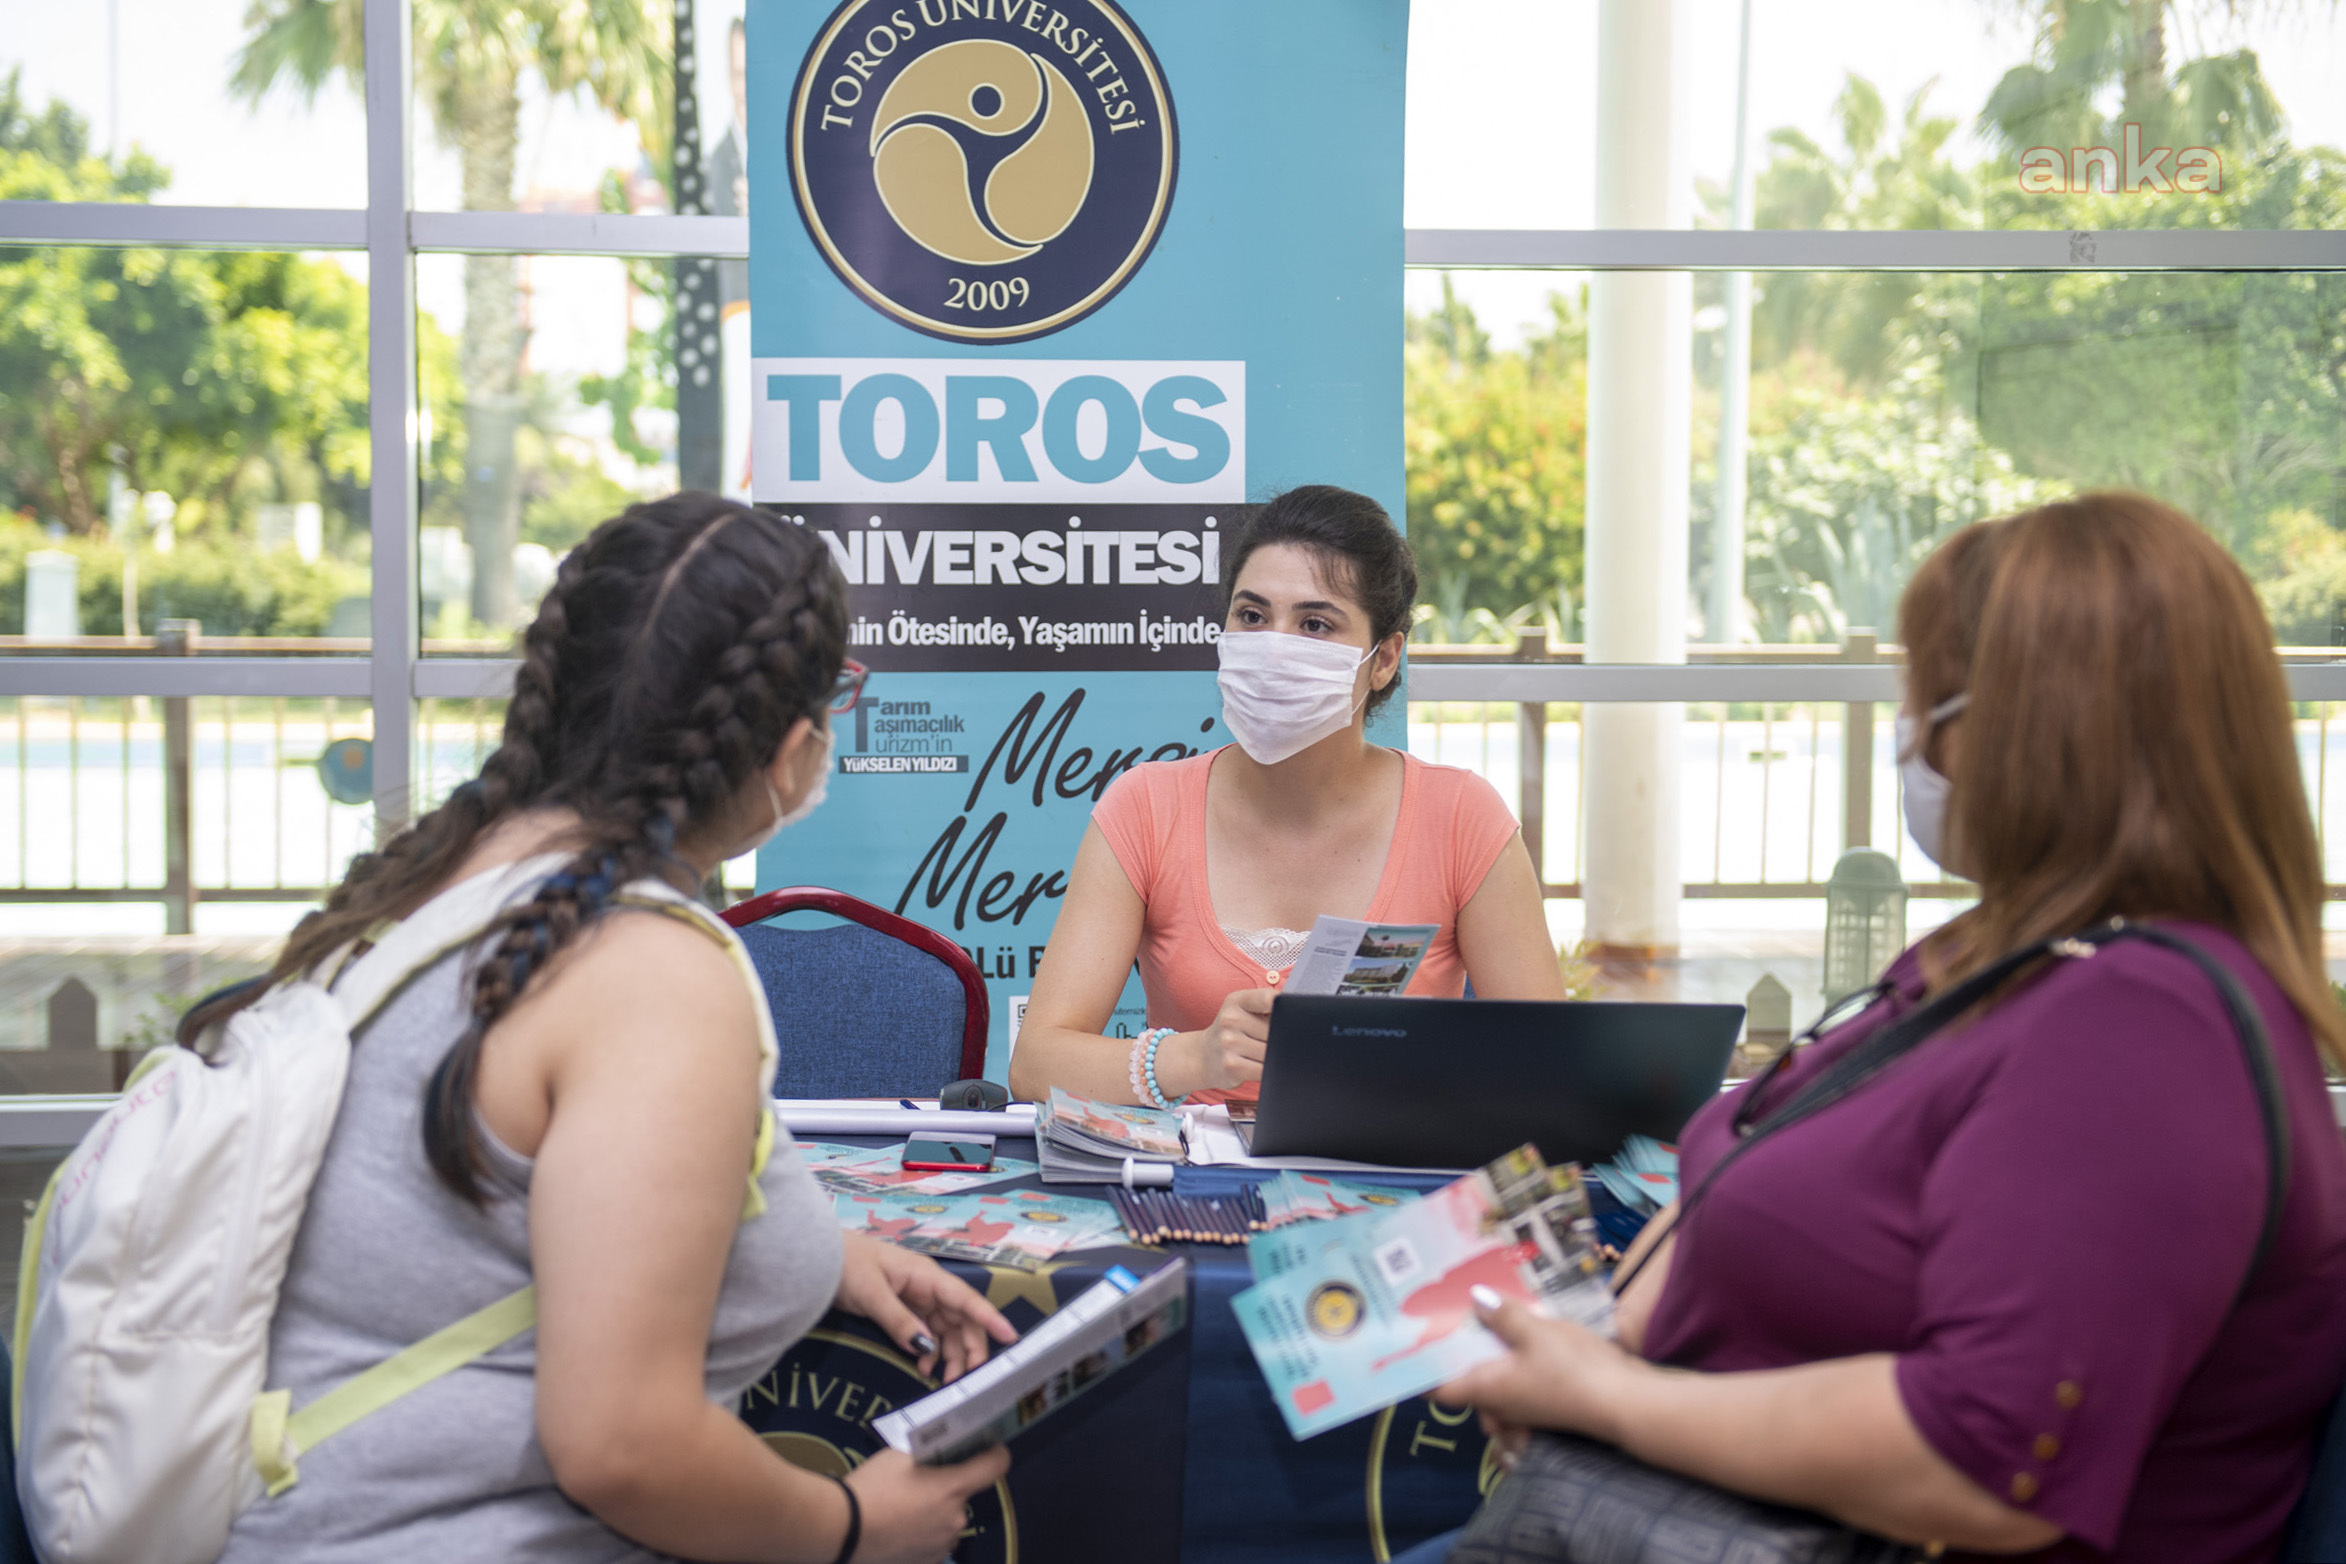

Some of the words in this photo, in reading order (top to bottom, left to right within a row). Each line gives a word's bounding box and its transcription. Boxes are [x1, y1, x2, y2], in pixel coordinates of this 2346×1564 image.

[820, 9, 917, 131] TOROS
[943, 276, 1030, 312] 2009
[767, 373, 1231, 484] TOROS
[781, 515, 1220, 585] NİVERSİTESİ
[888, 609, 1015, 651] Ötesinde,
[1018, 616, 1135, 652] Yaşamın
